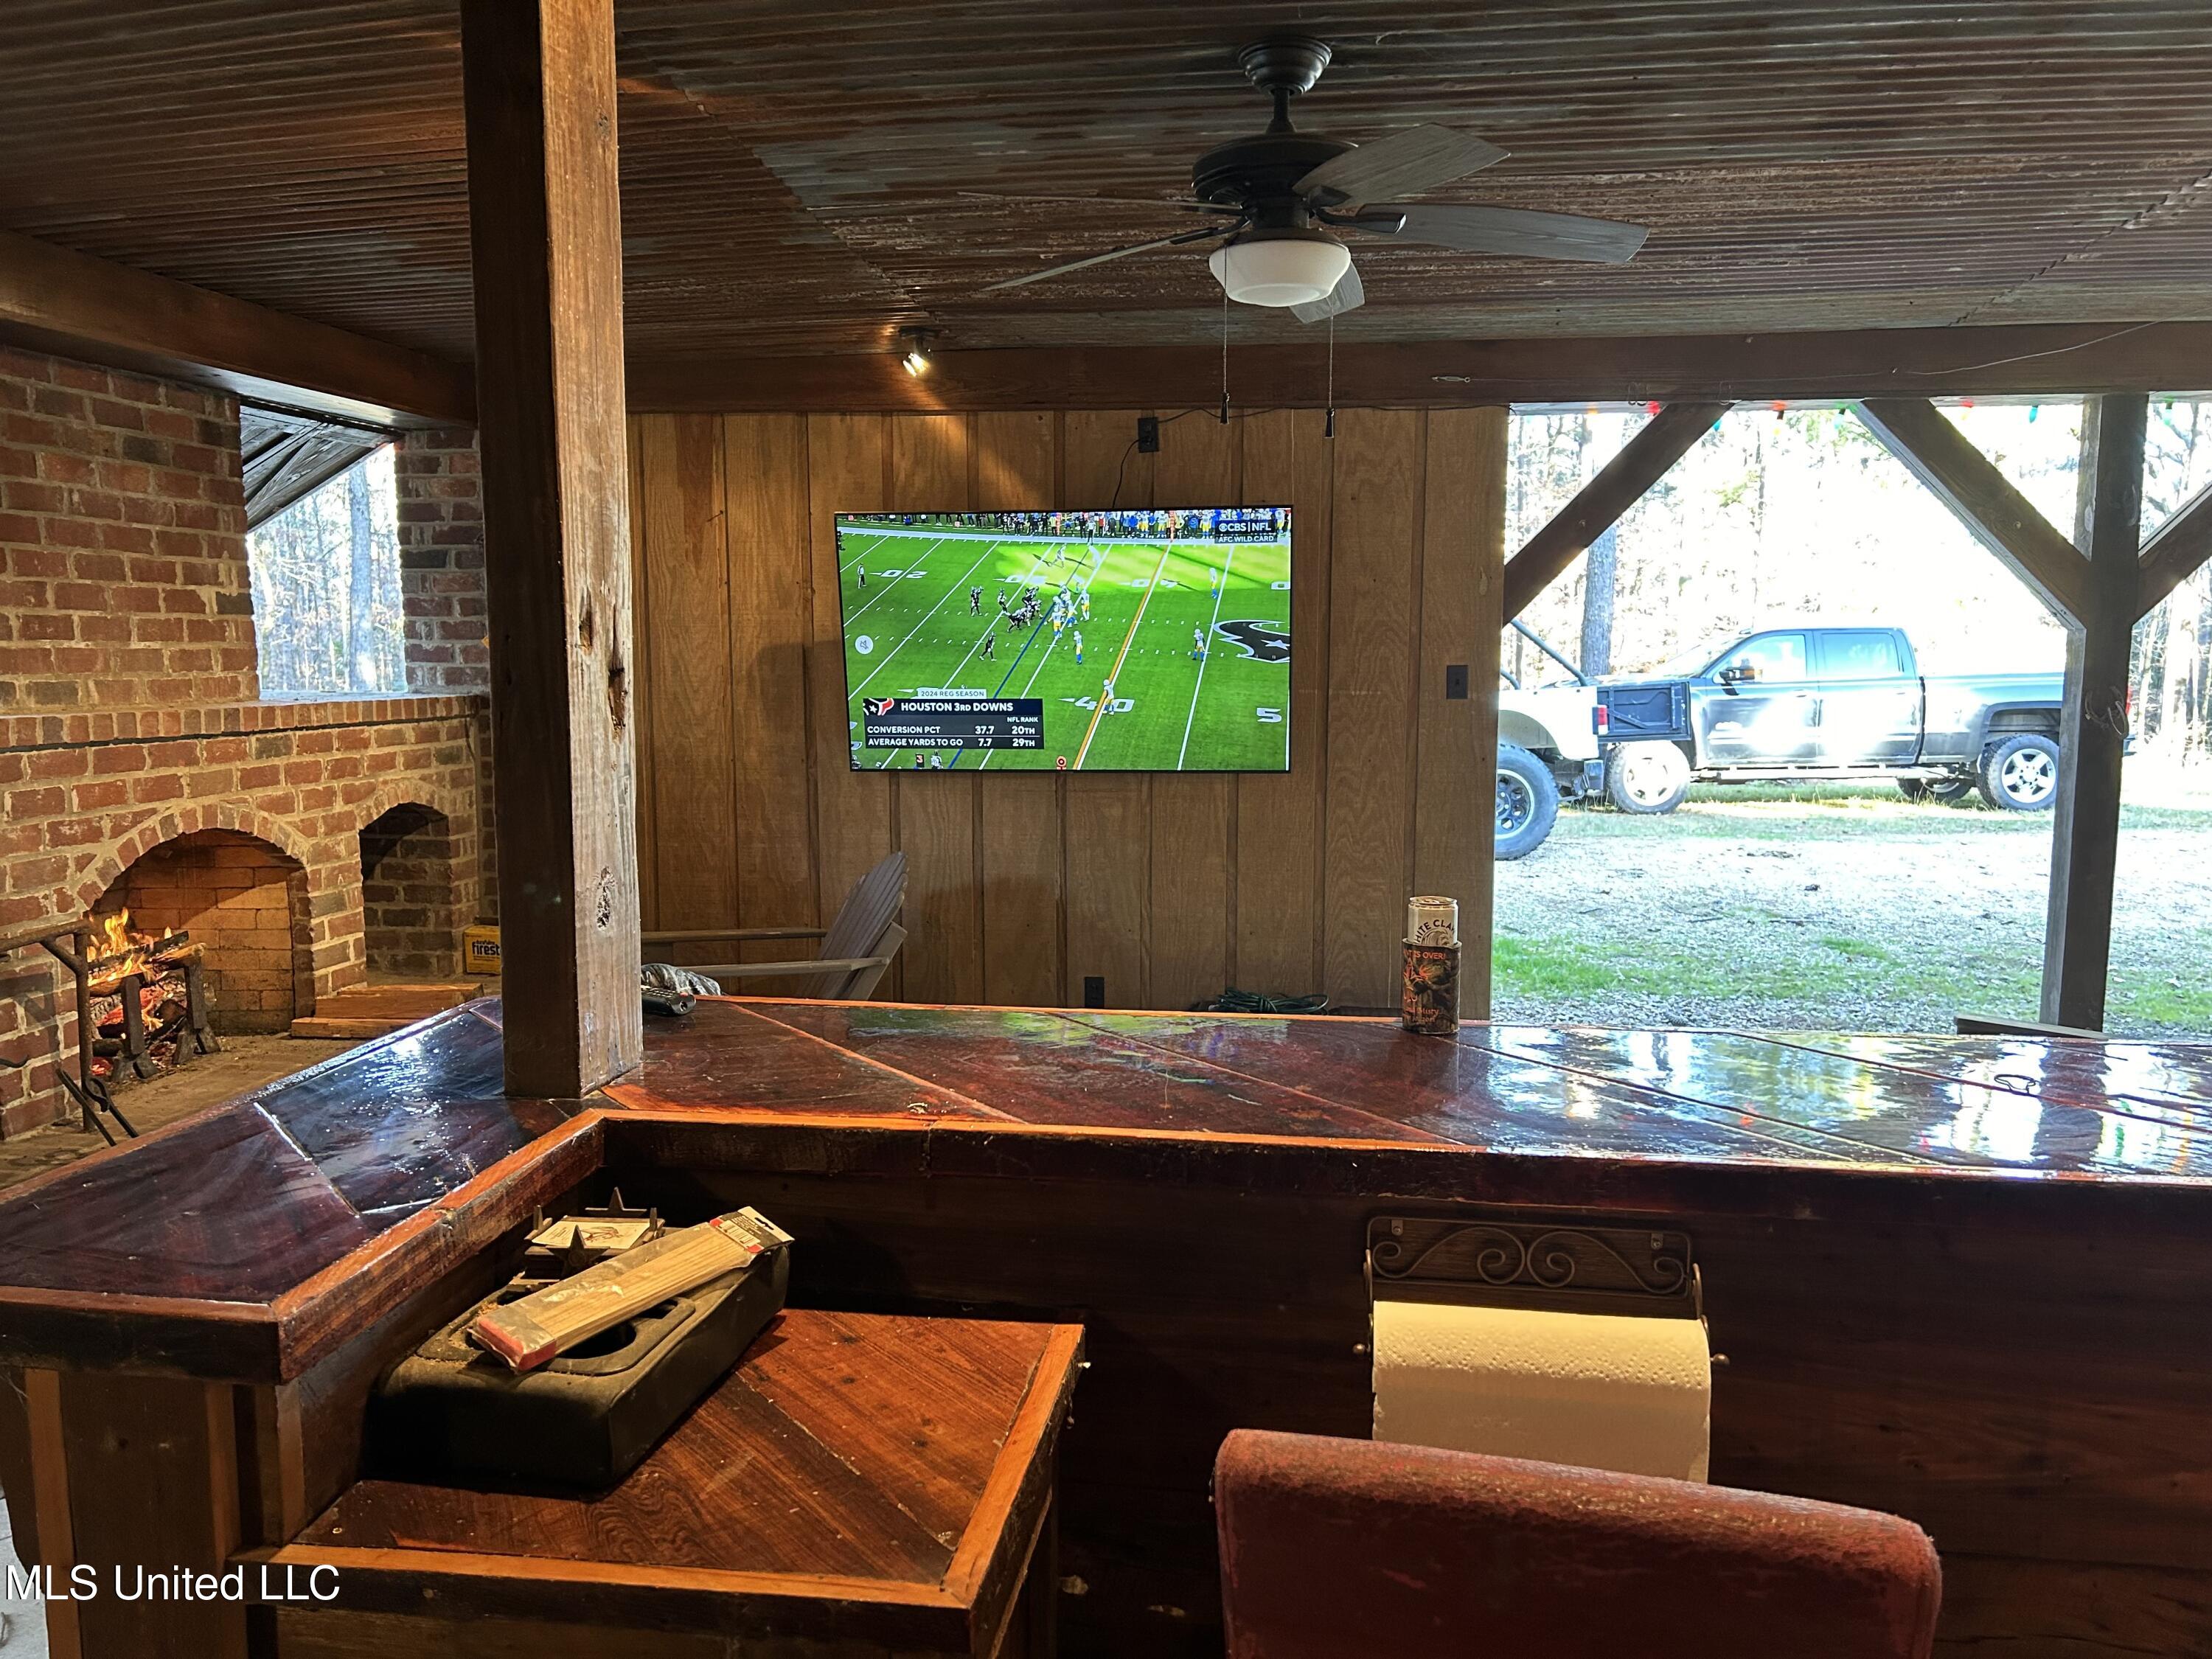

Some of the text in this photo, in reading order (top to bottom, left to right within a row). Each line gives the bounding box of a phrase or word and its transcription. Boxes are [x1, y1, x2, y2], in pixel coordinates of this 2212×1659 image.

[1227, 522, 1272, 532] CBS NFL
[901, 702, 1014, 712] HOUSTON 3RD DOWNS
[866, 725, 1035, 734] CONVERSION PCT 37.7 20TH
[868, 738, 1035, 747] AVERAGE YARDS TO GO 7.7 29TH
[1415, 922, 1432, 943] HITE
[1422, 951, 1446, 960] OVER!
